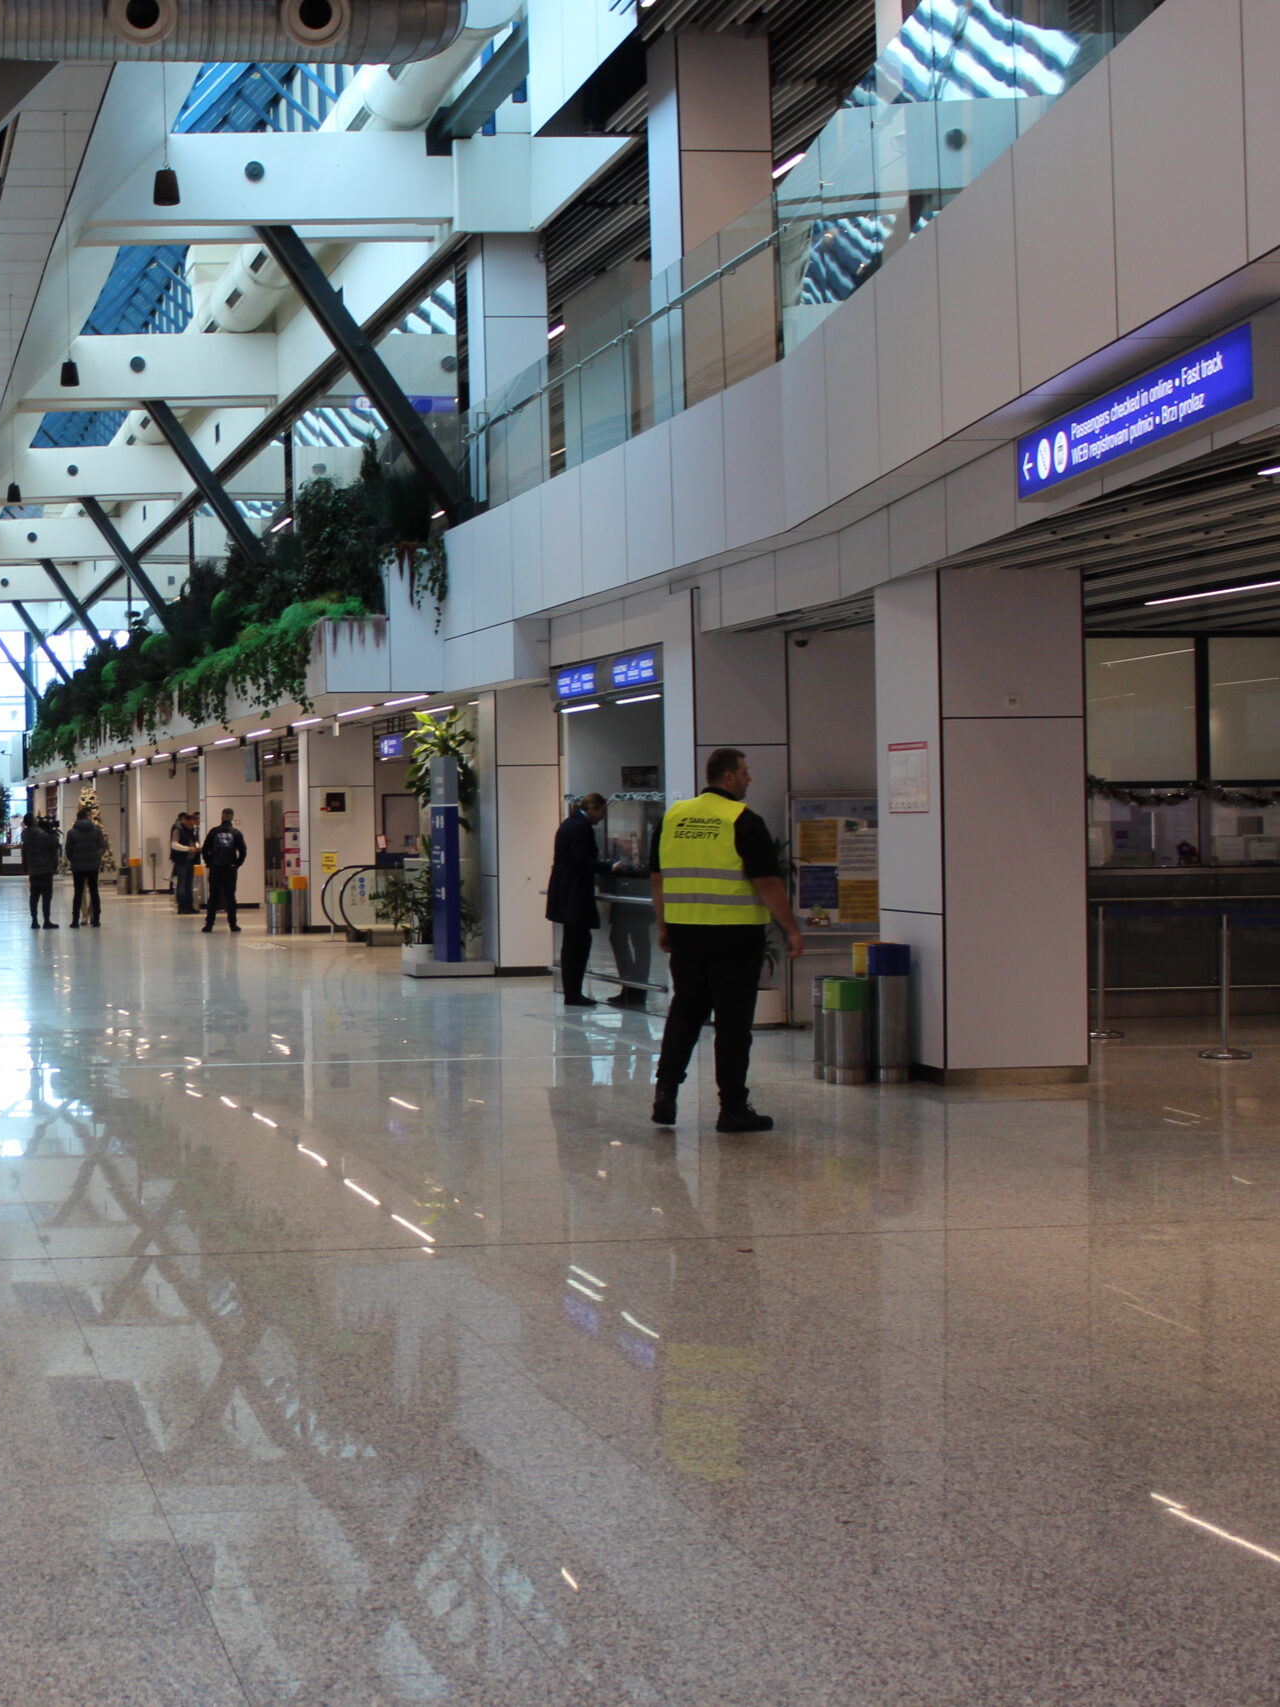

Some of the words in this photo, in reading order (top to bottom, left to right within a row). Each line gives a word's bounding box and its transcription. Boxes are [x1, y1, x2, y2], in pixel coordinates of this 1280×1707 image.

[1071, 411, 1110, 440] Passengers
[1110, 391, 1140, 421] checked
[1141, 389, 1148, 407] in
[1149, 379, 1174, 402] online
[1181, 367, 1200, 387] Fast
[1201, 351, 1223, 378] track
[1071, 443, 1088, 465] WEB
[1089, 423, 1129, 459] registrovani
[1130, 412, 1154, 444] putnici
[1162, 401, 1177, 425] Brzi
[1179, 393, 1205, 422] prolaz
[674, 831, 720, 839] SECURITY
